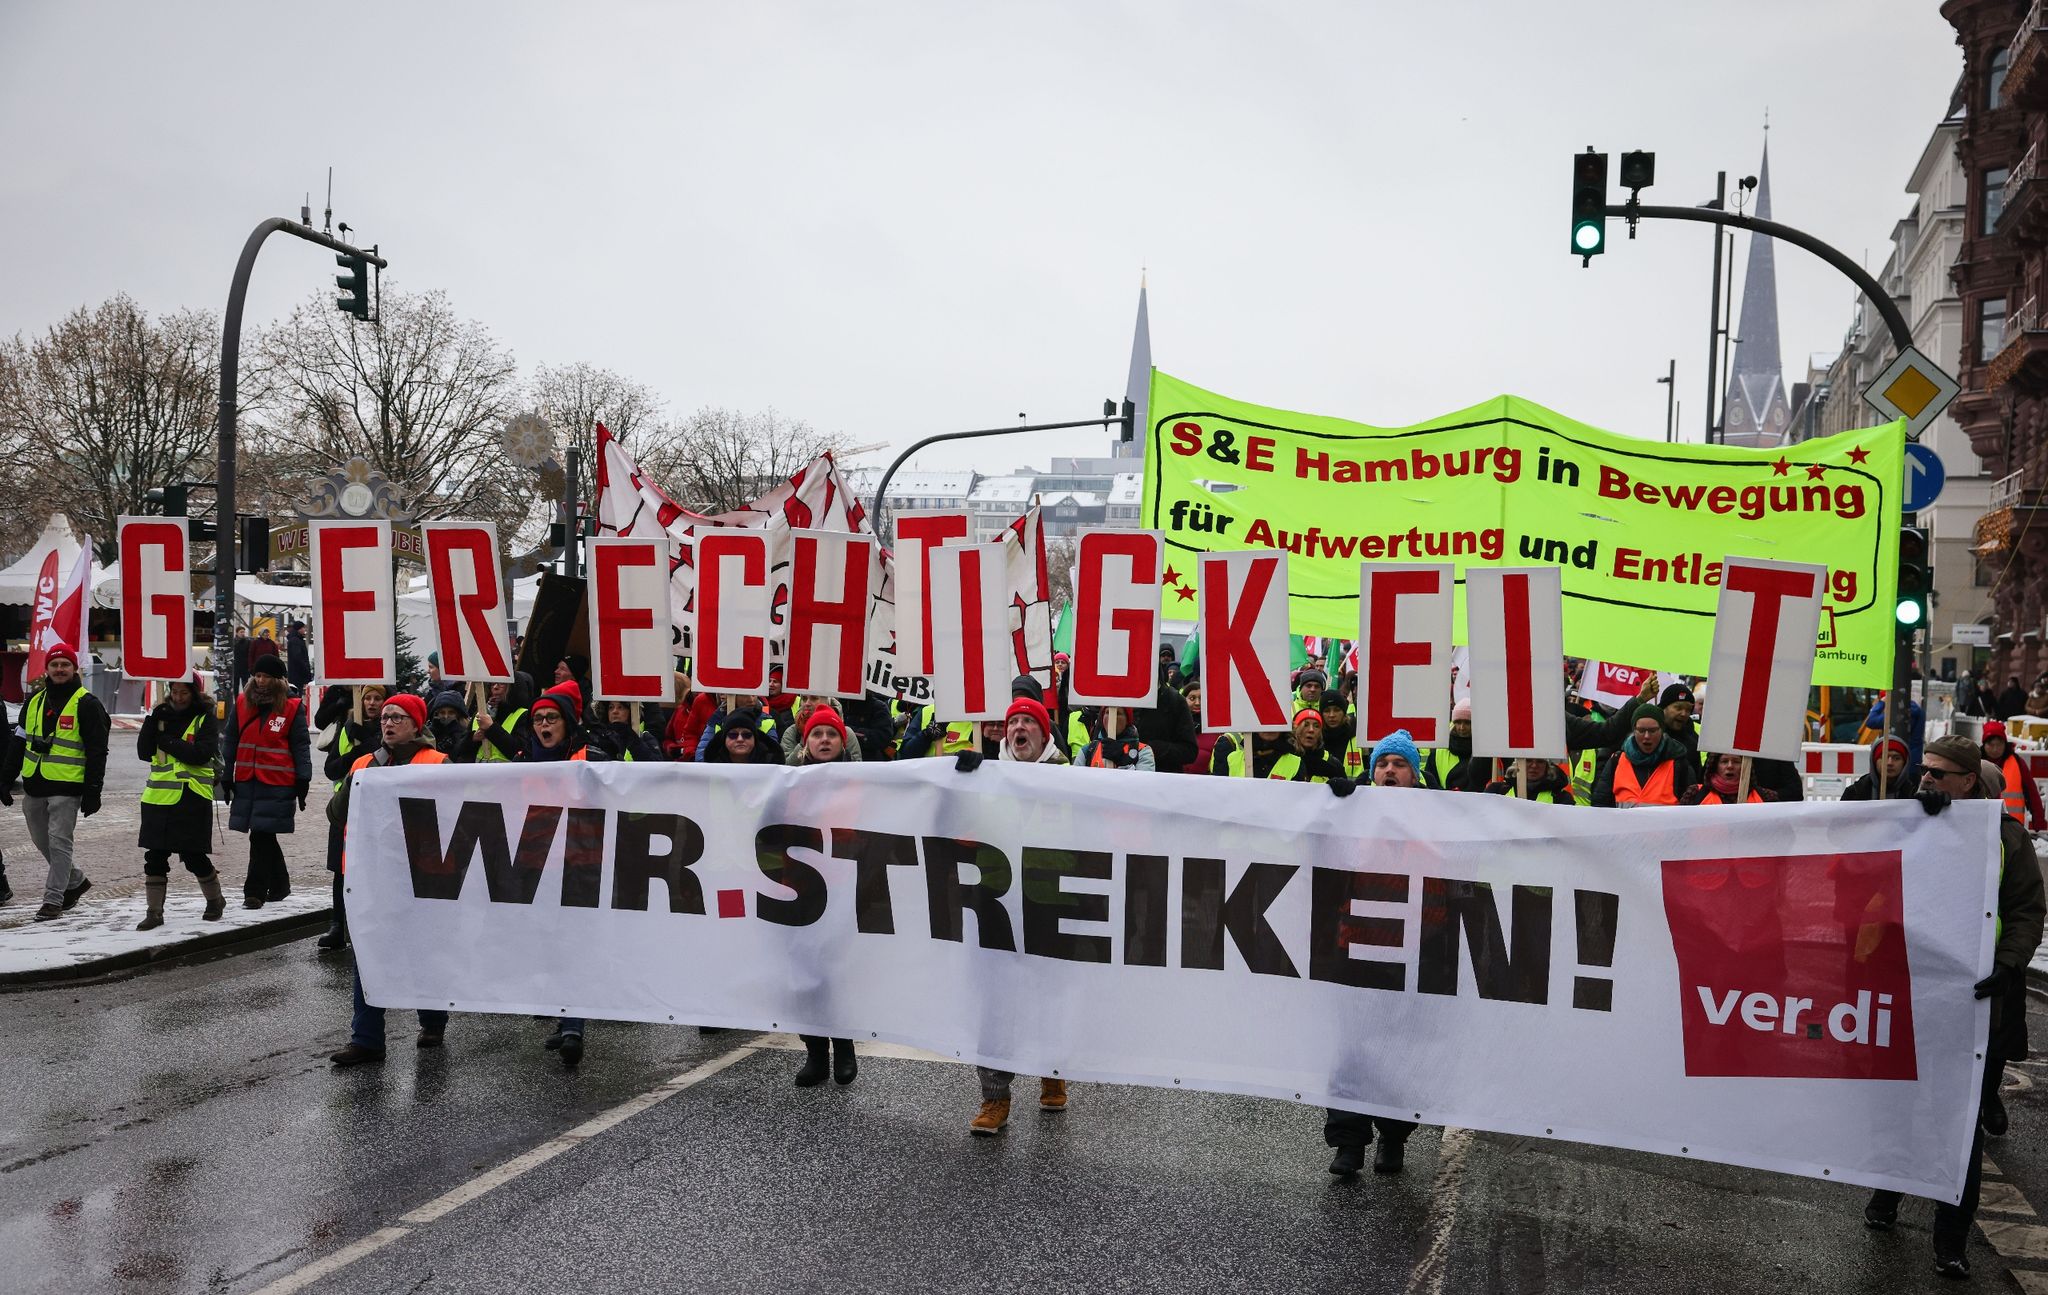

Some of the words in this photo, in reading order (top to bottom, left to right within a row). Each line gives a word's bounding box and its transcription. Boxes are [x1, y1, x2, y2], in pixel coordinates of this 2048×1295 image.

[1170, 420, 1276, 473] S&E
[1296, 447, 1521, 484] Hamburg
[1537, 447, 1580, 488] in
[1598, 462, 1866, 520] Bewegung
[1170, 500, 1234, 536] für
[1243, 519, 1505, 561] Aufwertung
[1518, 534, 1597, 572] und
[1614, 548, 1857, 603] Entlag
[1696, 986, 1892, 1048] ver.di
